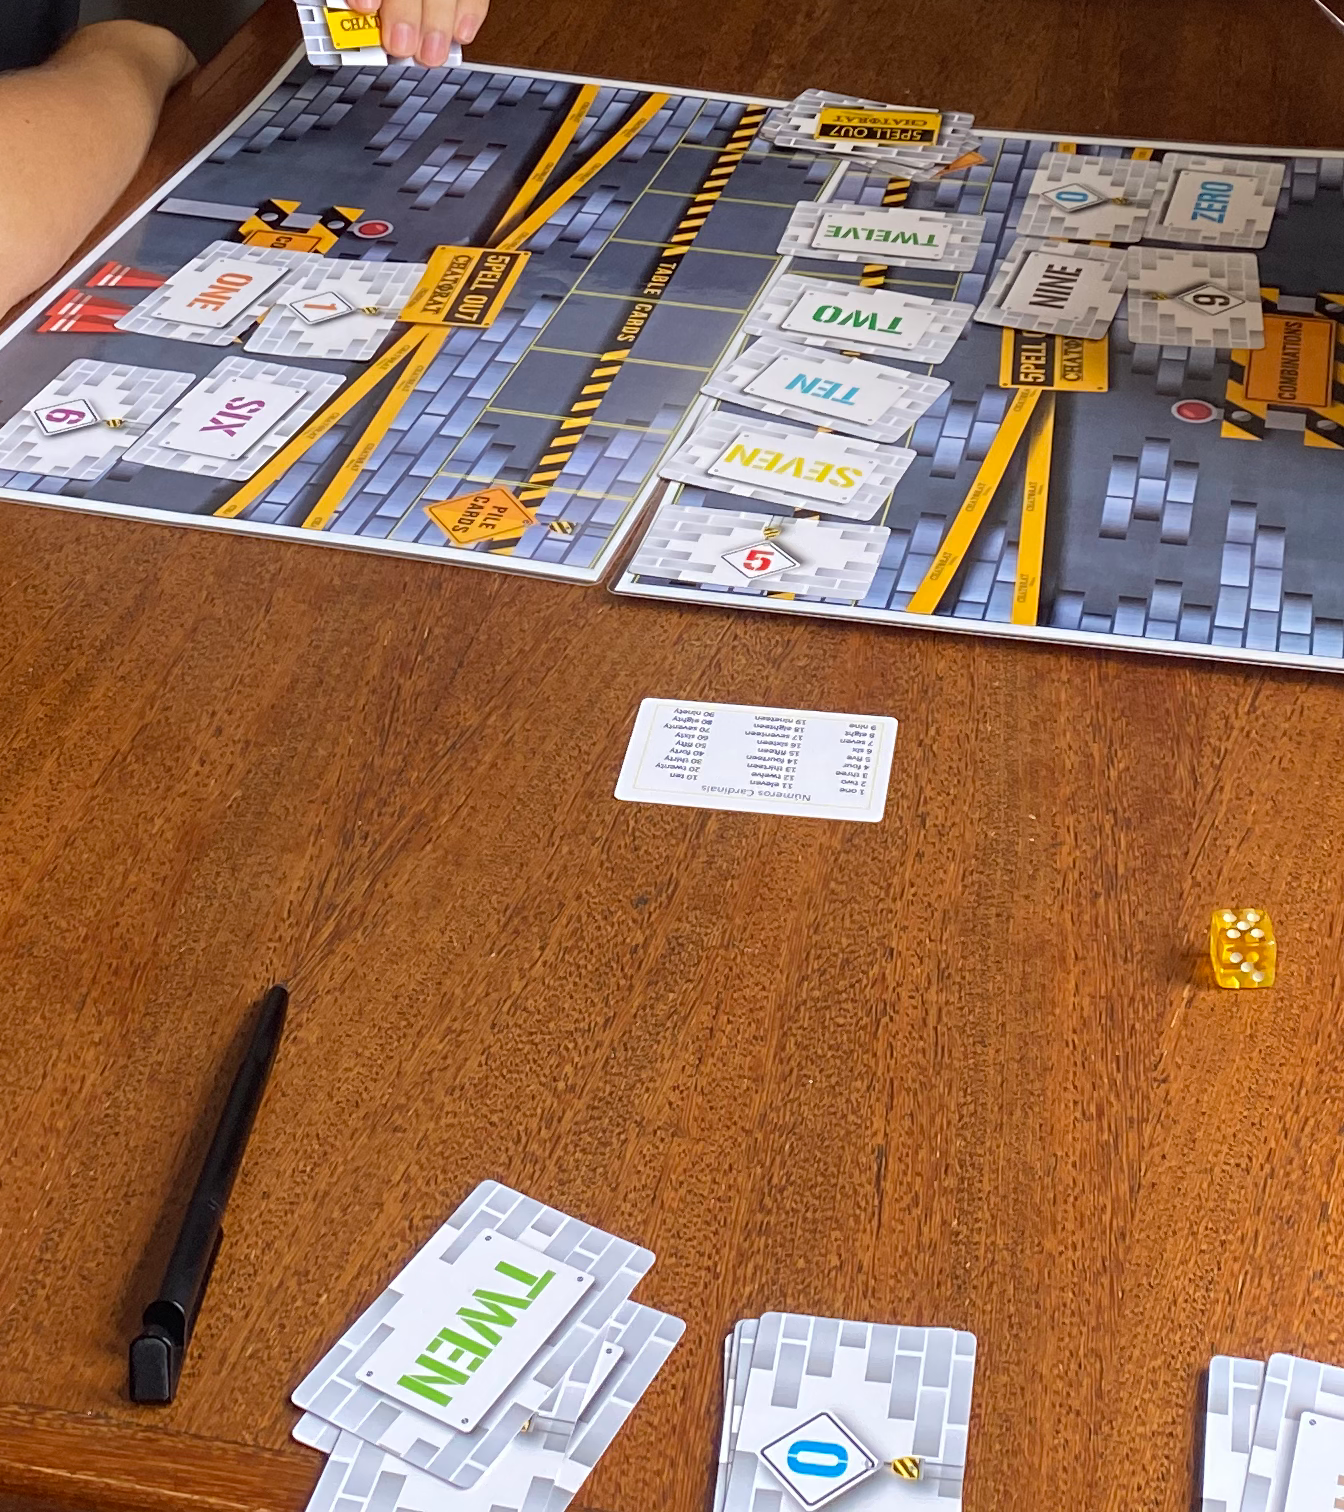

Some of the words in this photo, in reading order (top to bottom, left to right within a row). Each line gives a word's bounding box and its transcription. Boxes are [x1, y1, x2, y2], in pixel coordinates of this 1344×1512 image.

[1191, 181, 1234, 224] ZERO
[823, 224, 939, 247] TWELVE
[186, 272, 253, 312] ONE
[643, 262, 677, 296] TABLE
[1028, 264, 1083, 310] NINE
[303, 303, 337, 311] 1
[1193, 293, 1230, 307] 9
[616, 303, 653, 342] CARDS
[812, 305, 903, 335] TWO
[1277, 321, 1303, 401] COMBINATIONS
[785, 373, 861, 406] TEN
[45, 408, 86, 425] 6
[199, 396, 266, 437] SIX
[723, 444, 863, 488] SEVEN
[451, 496, 490, 533] CARDS
[477, 505, 508, 530] PILE
[742, 549, 774, 571] 5
[745, 731, 790, 739] seventeen
[746, 755, 785, 764] fourteen
[747, 763, 783, 771] thirteen
[758, 791, 811, 801] Números
[396, 1261, 556, 1407] TWEN
